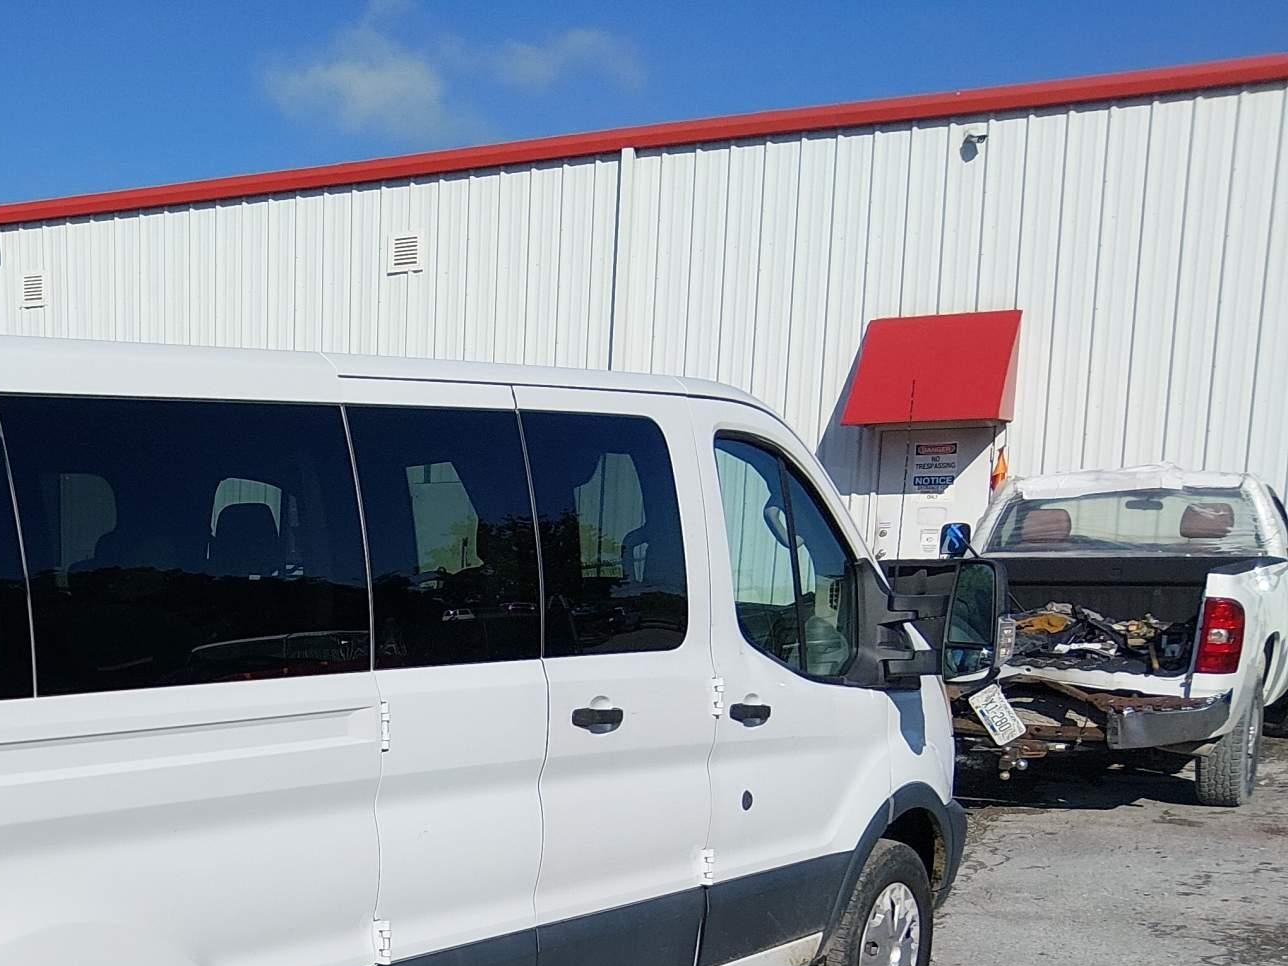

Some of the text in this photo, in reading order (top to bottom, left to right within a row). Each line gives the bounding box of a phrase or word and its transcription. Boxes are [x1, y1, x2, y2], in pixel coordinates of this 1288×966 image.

[919, 446, 952, 454] DANGER
[915, 462, 956, 470] TRESPASSING
[915, 476, 953, 485] NOTICE
